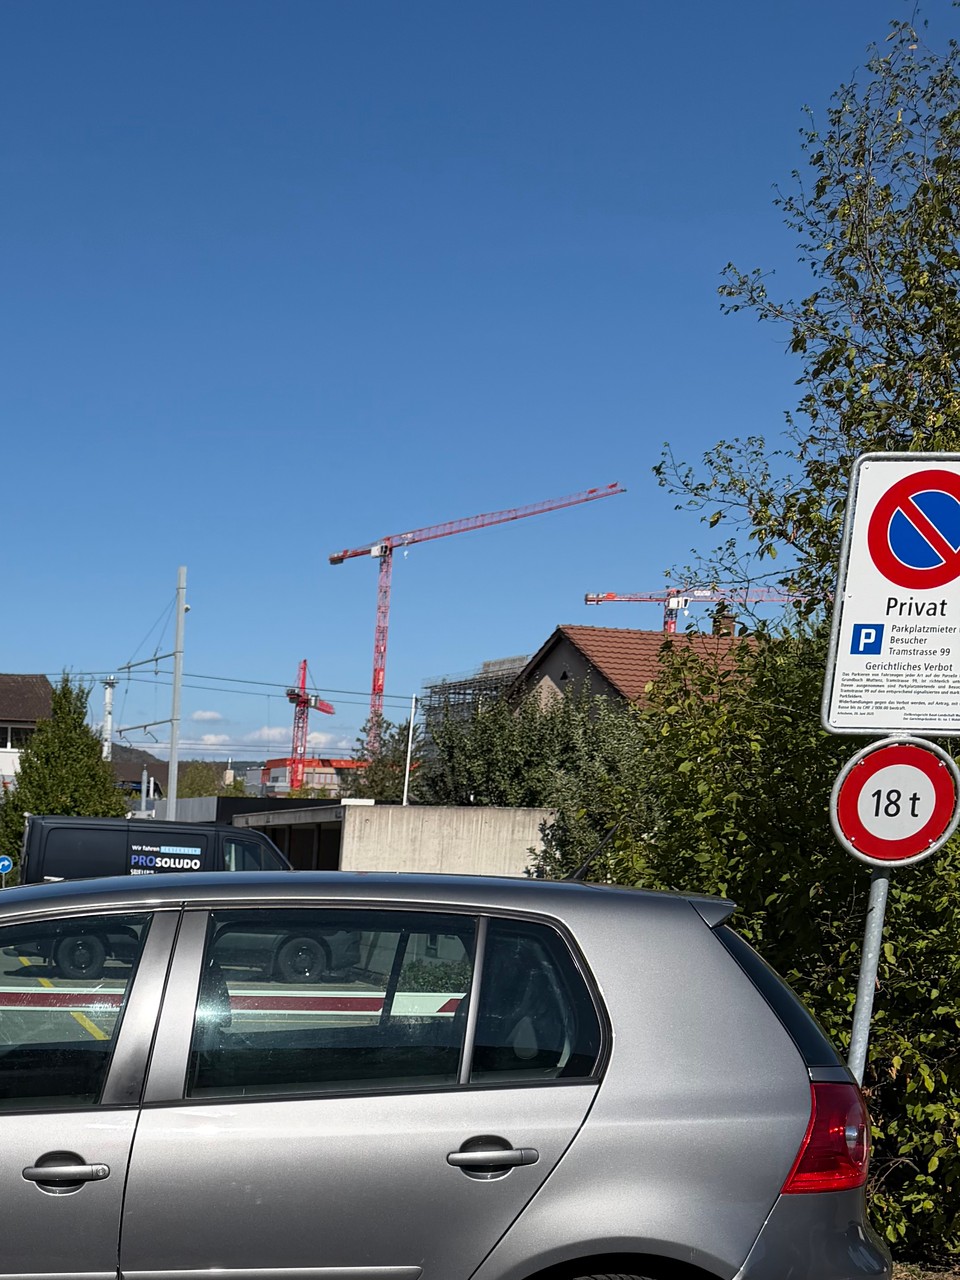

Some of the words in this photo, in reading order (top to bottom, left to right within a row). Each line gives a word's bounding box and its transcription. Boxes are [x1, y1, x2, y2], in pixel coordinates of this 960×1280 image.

[886, 596, 948, 617] Privat
[891, 624, 957, 635] Parkplatzmieter
[858, 628, 876, 652] P
[889, 635, 928, 645] Besucher
[888, 647, 938, 656] Tramstrasse
[940, 647, 951, 656] 99
[865, 661, 922, 671] Gerichtliches
[924, 662, 953, 672] Verbot
[871, 789, 902, 818] 18
[909, 791, 921, 818] t
[131, 855, 200, 870] PROSOLUDO
